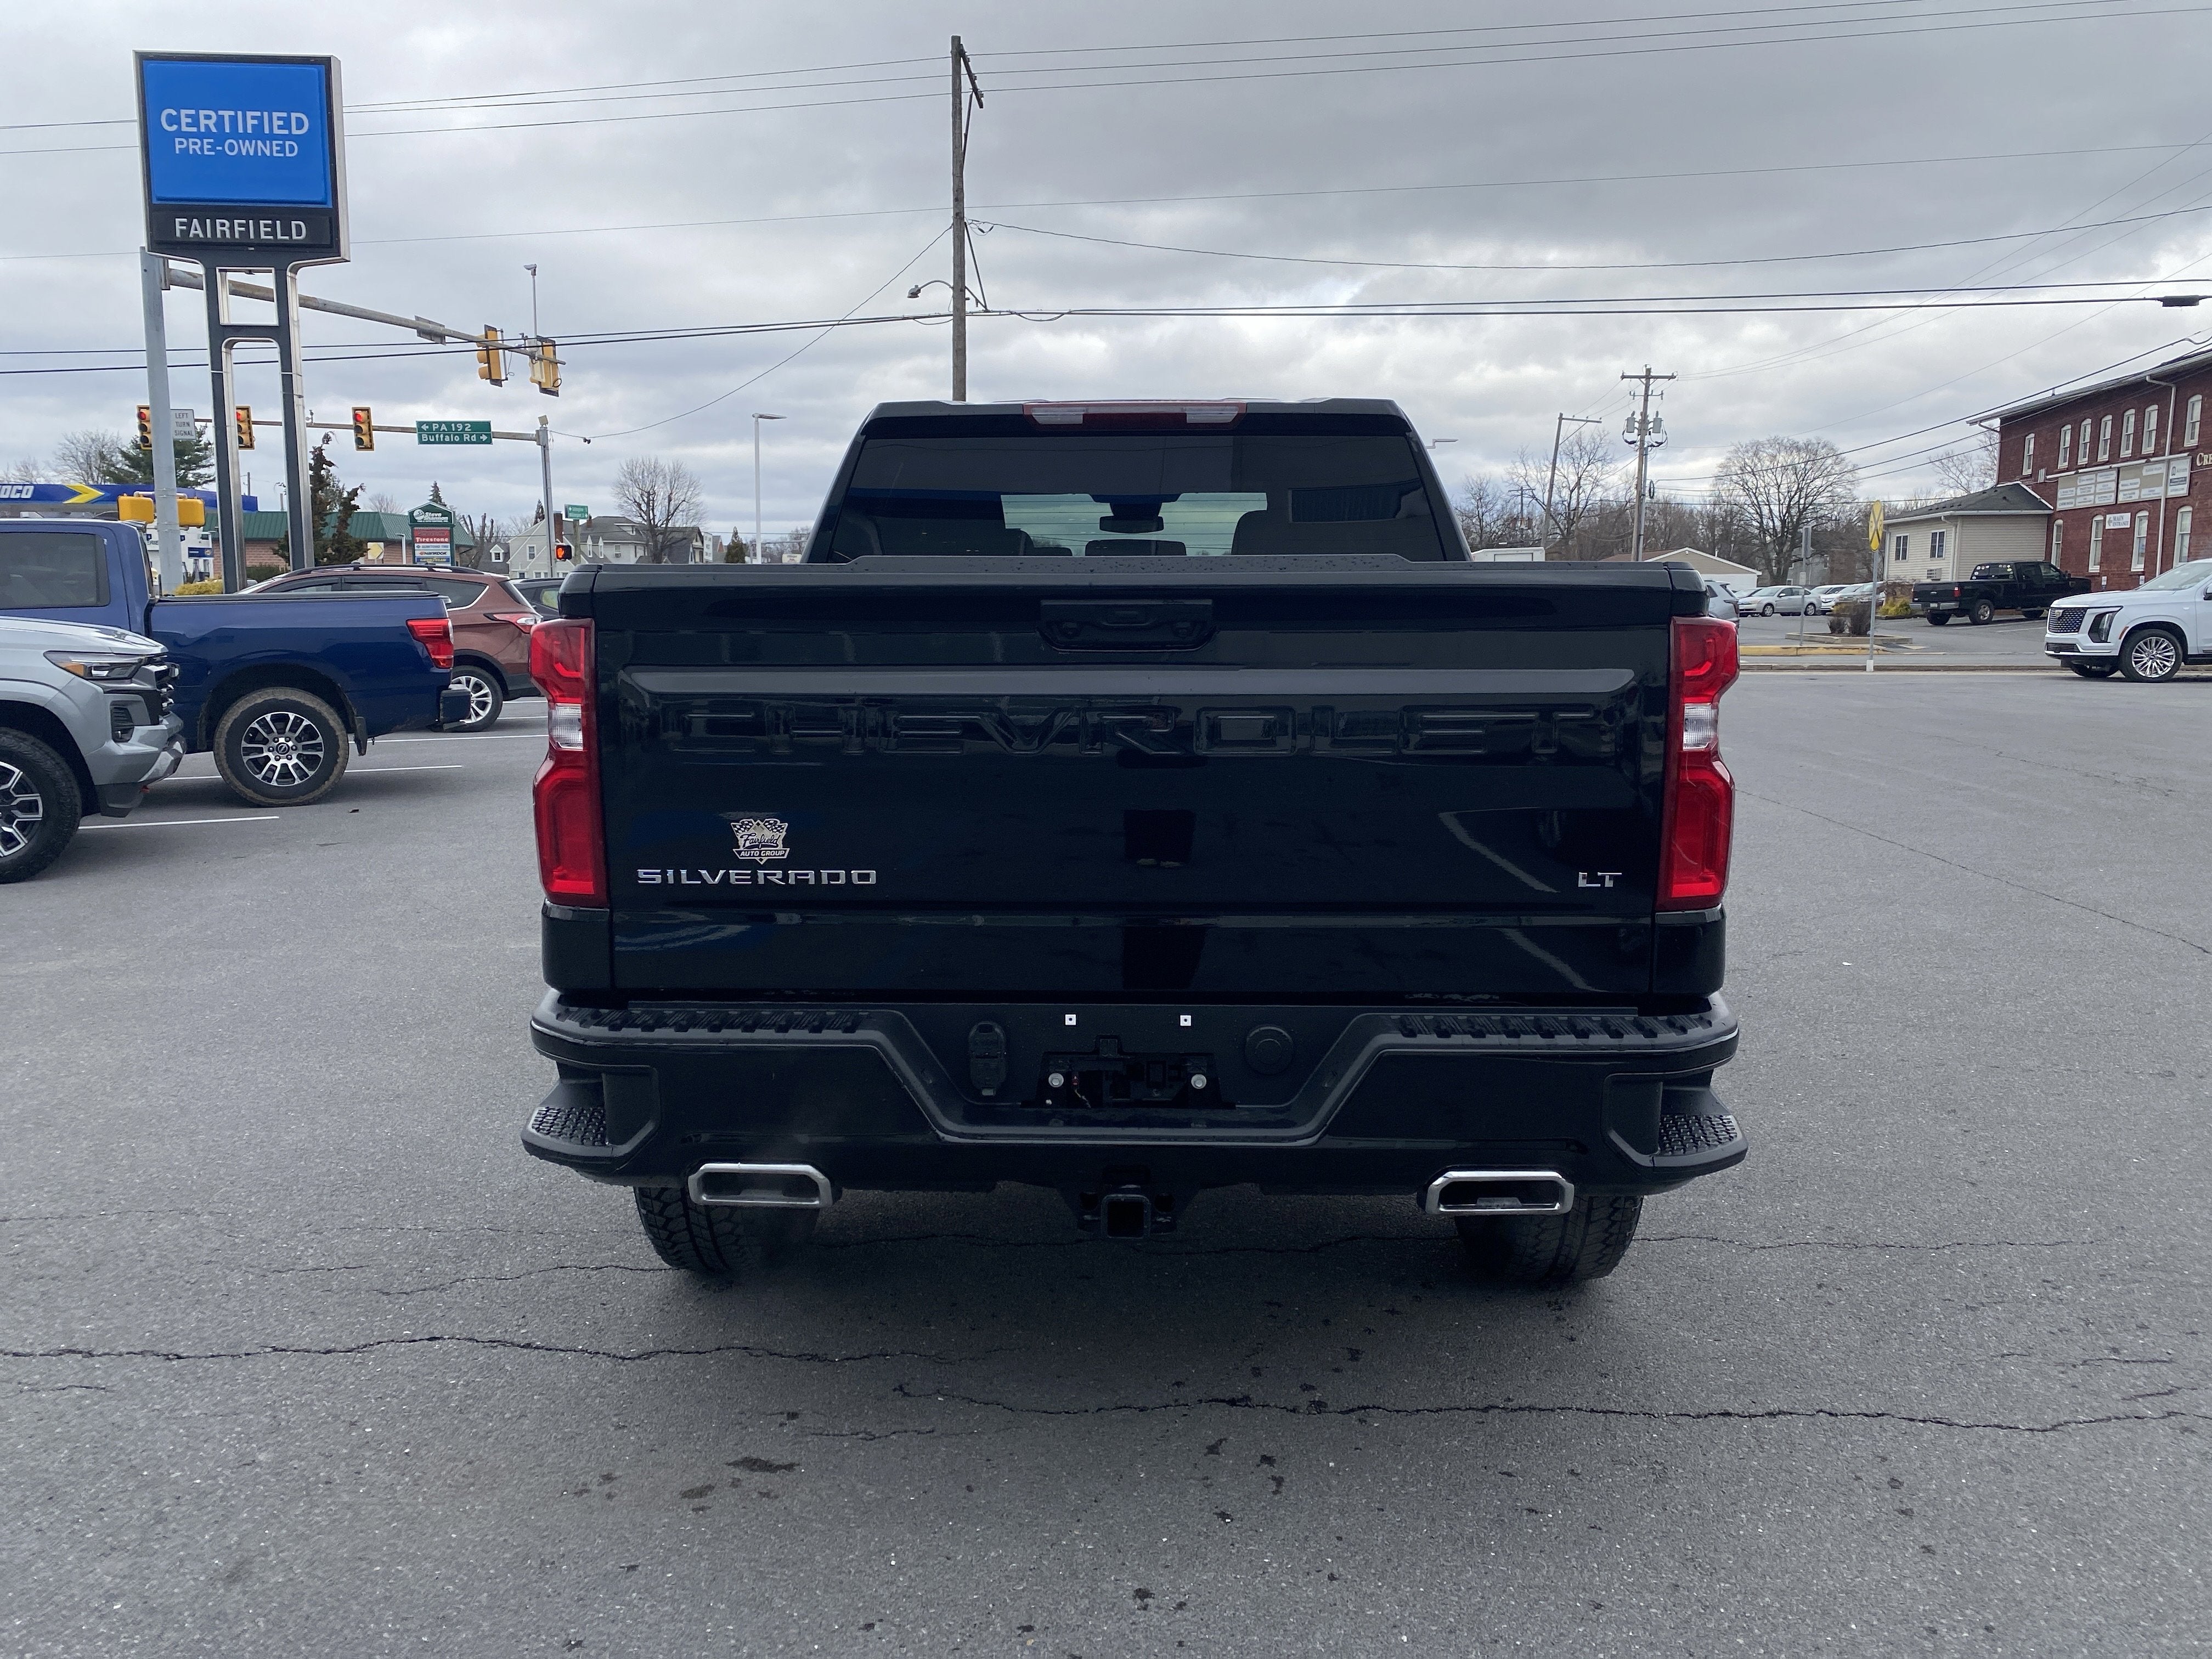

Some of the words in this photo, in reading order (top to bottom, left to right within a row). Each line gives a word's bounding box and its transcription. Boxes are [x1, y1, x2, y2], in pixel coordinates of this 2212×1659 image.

[161, 108, 309, 135] CERTIFIED
[174, 138, 298, 157] PRE-OWNED
[174, 217, 307, 240] FAIRFIELD
[432, 423, 448, 431] PA
[451, 423, 471, 431] 192
[463, 433, 476, 442] Rd
[0, 485, 34, 499] OCO
[740, 832, 782, 848] Fairfield
[637, 869, 877, 884] SILVERADO
[1578, 872, 1622, 887] LT
